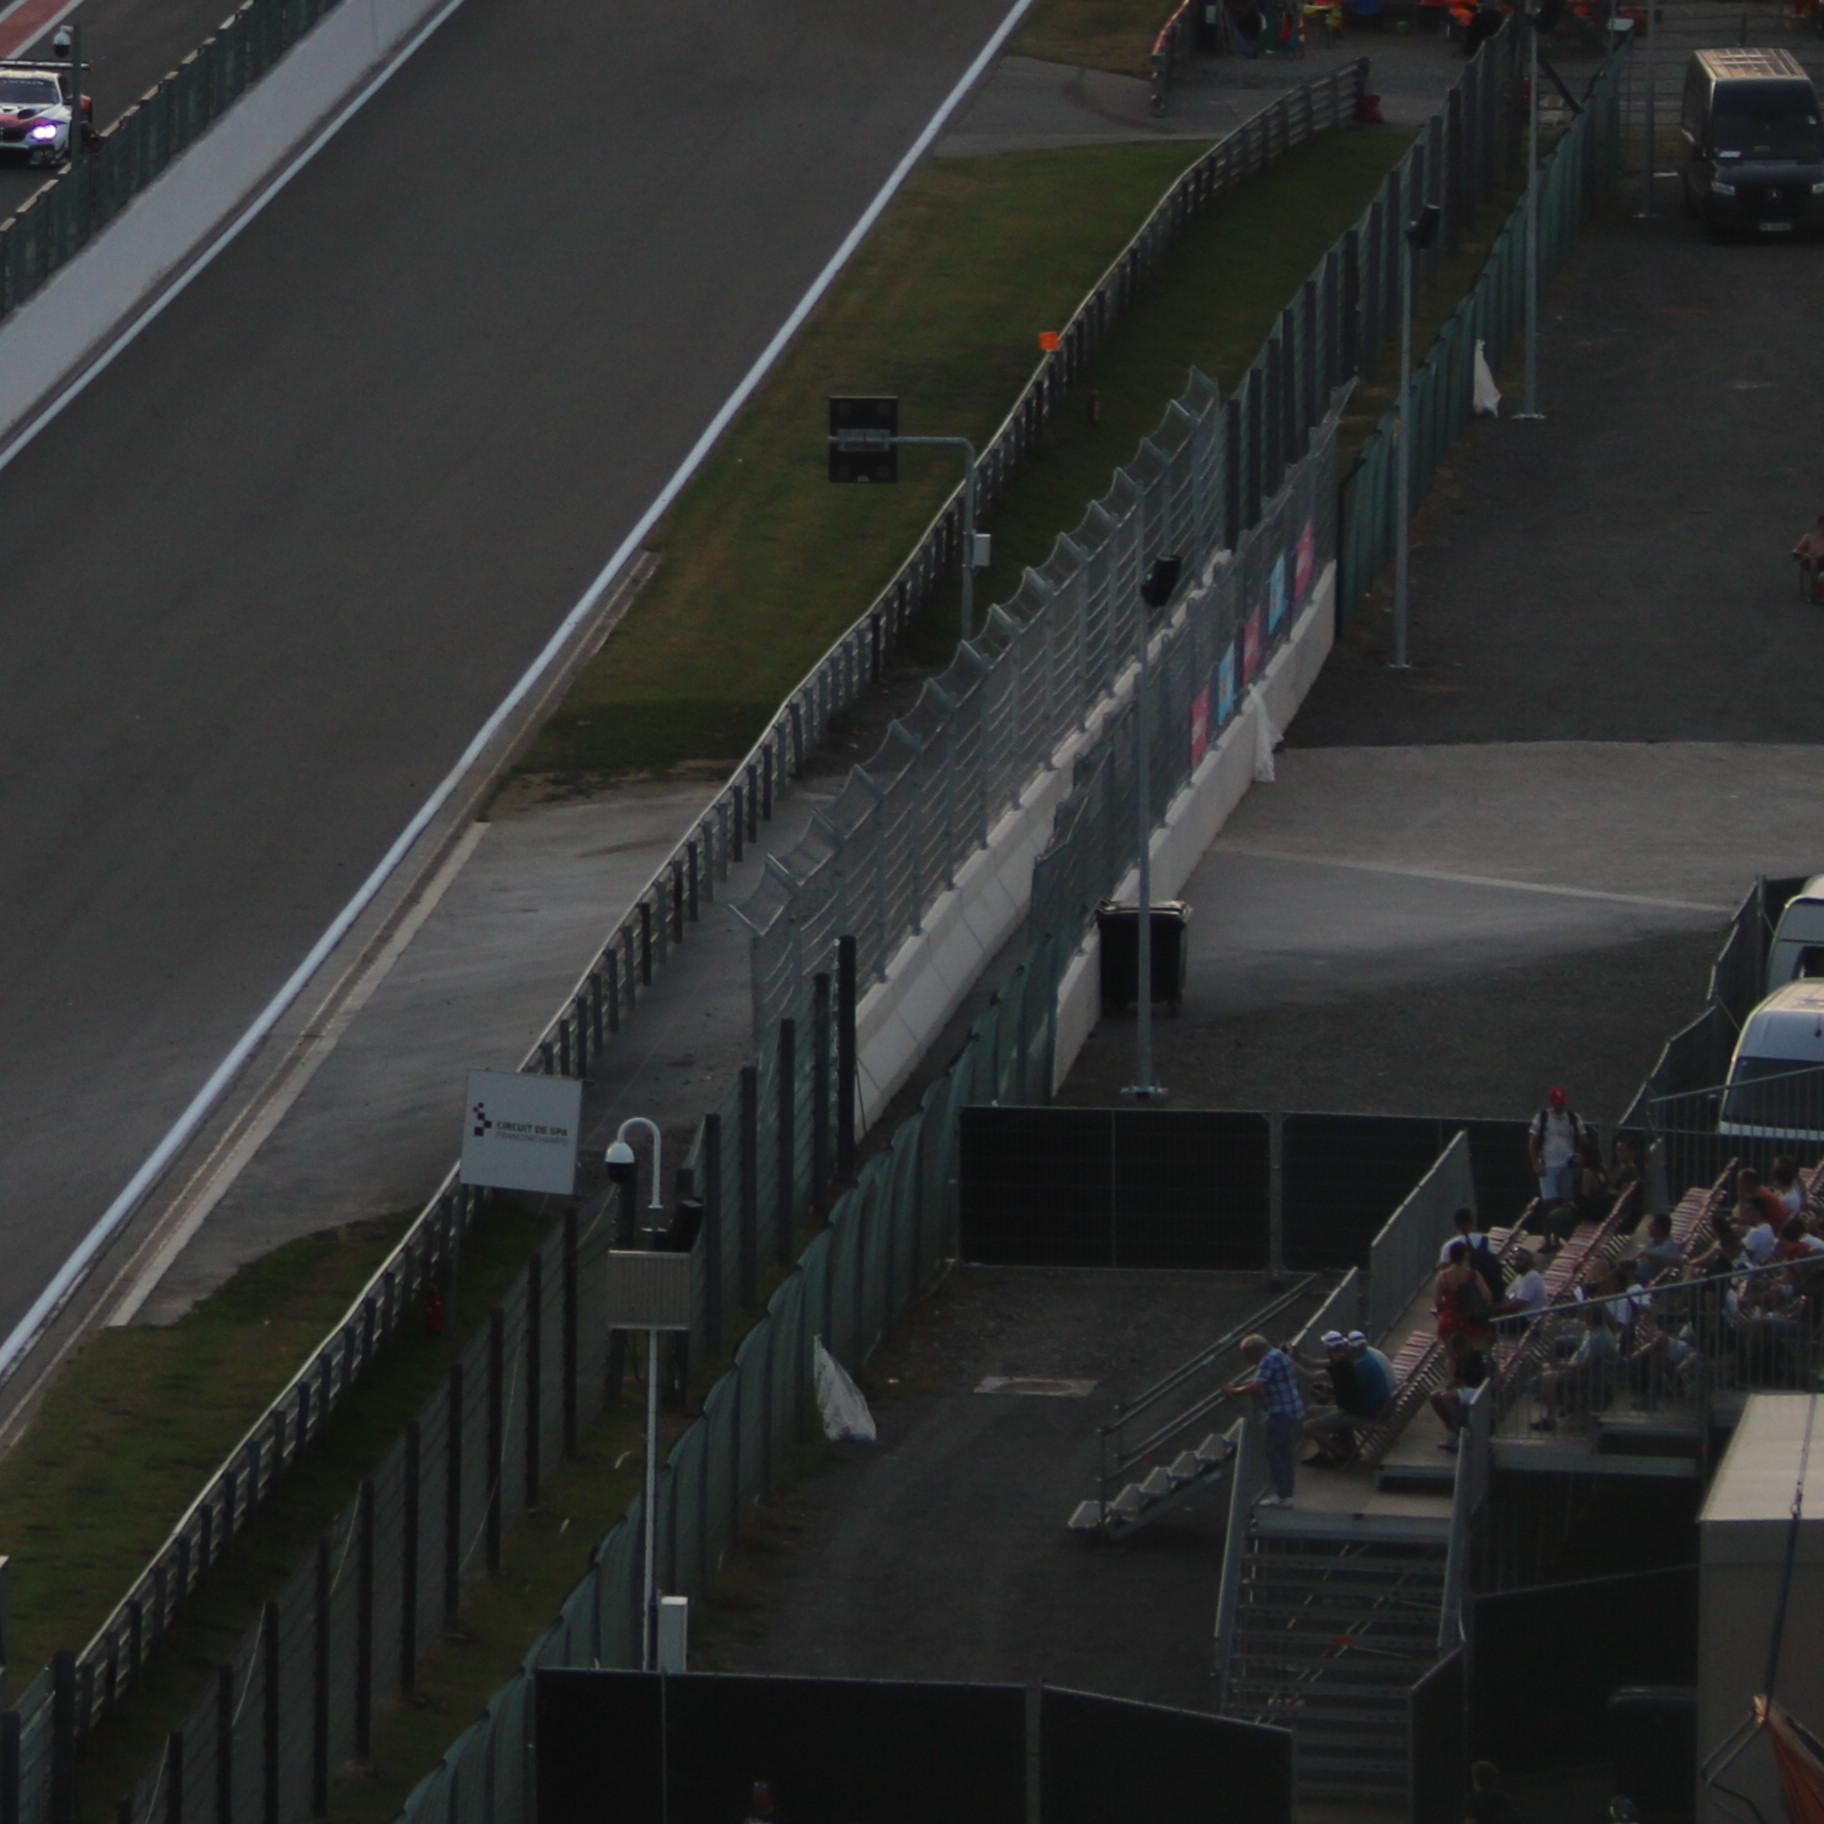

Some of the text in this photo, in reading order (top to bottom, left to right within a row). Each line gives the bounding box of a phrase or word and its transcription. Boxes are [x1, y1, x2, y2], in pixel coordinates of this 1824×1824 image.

[496, 1121, 568, 1137] CIRCUIT DE SPA
